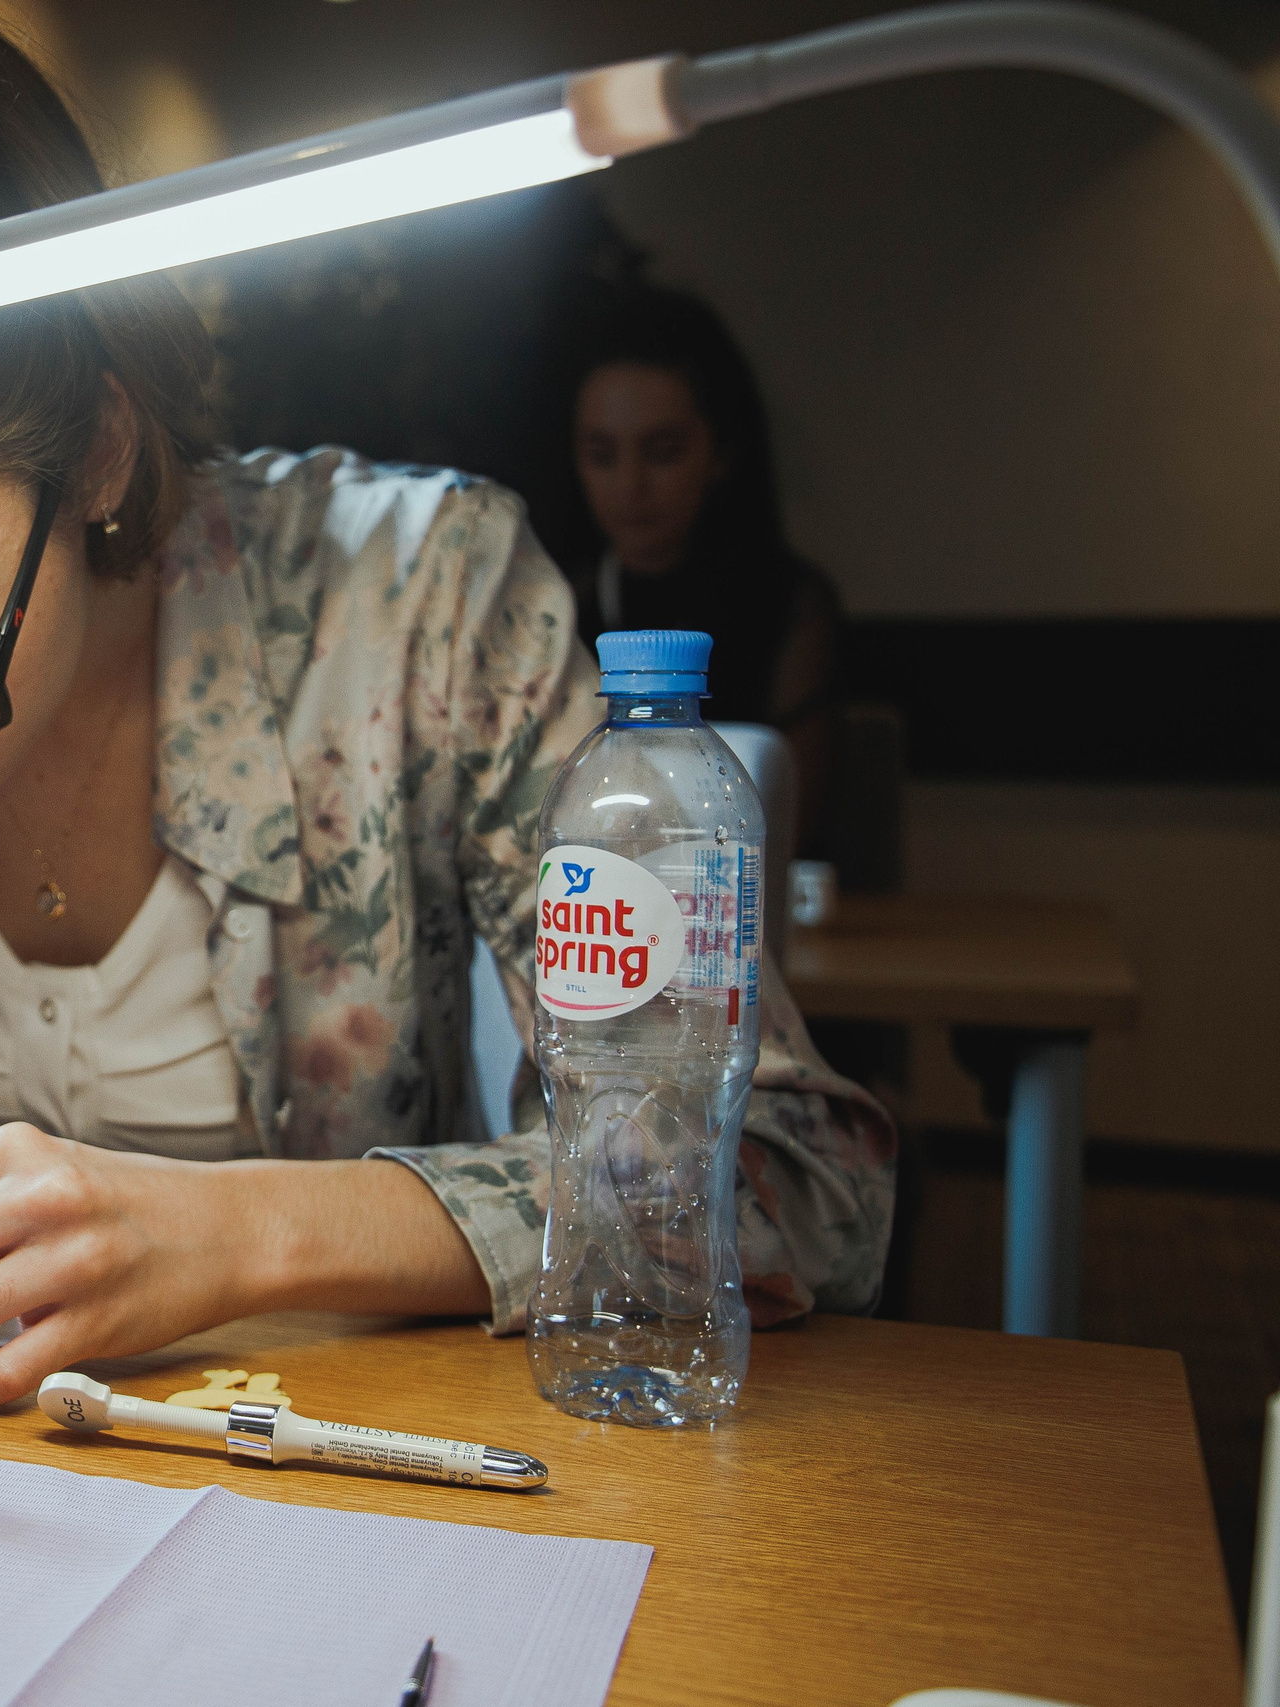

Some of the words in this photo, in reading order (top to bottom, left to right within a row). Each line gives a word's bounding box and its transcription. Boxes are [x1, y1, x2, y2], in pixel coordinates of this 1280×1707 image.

[542, 899, 634, 937] saint
[537, 935, 648, 988] spring
[565, 983, 587, 993] STILL
[63, 1397, 85, 1422] OcE
[328, 1439, 348, 1447] GmbH
[349, 1442, 388, 1453] Deutschland
[389, 1448, 409, 1456] Dental
[411, 1450, 443, 1461] Tokuyama
[410, 1457, 443, 1467] Tokuyama
[410, 1463, 442, 1473] Tokuyama
